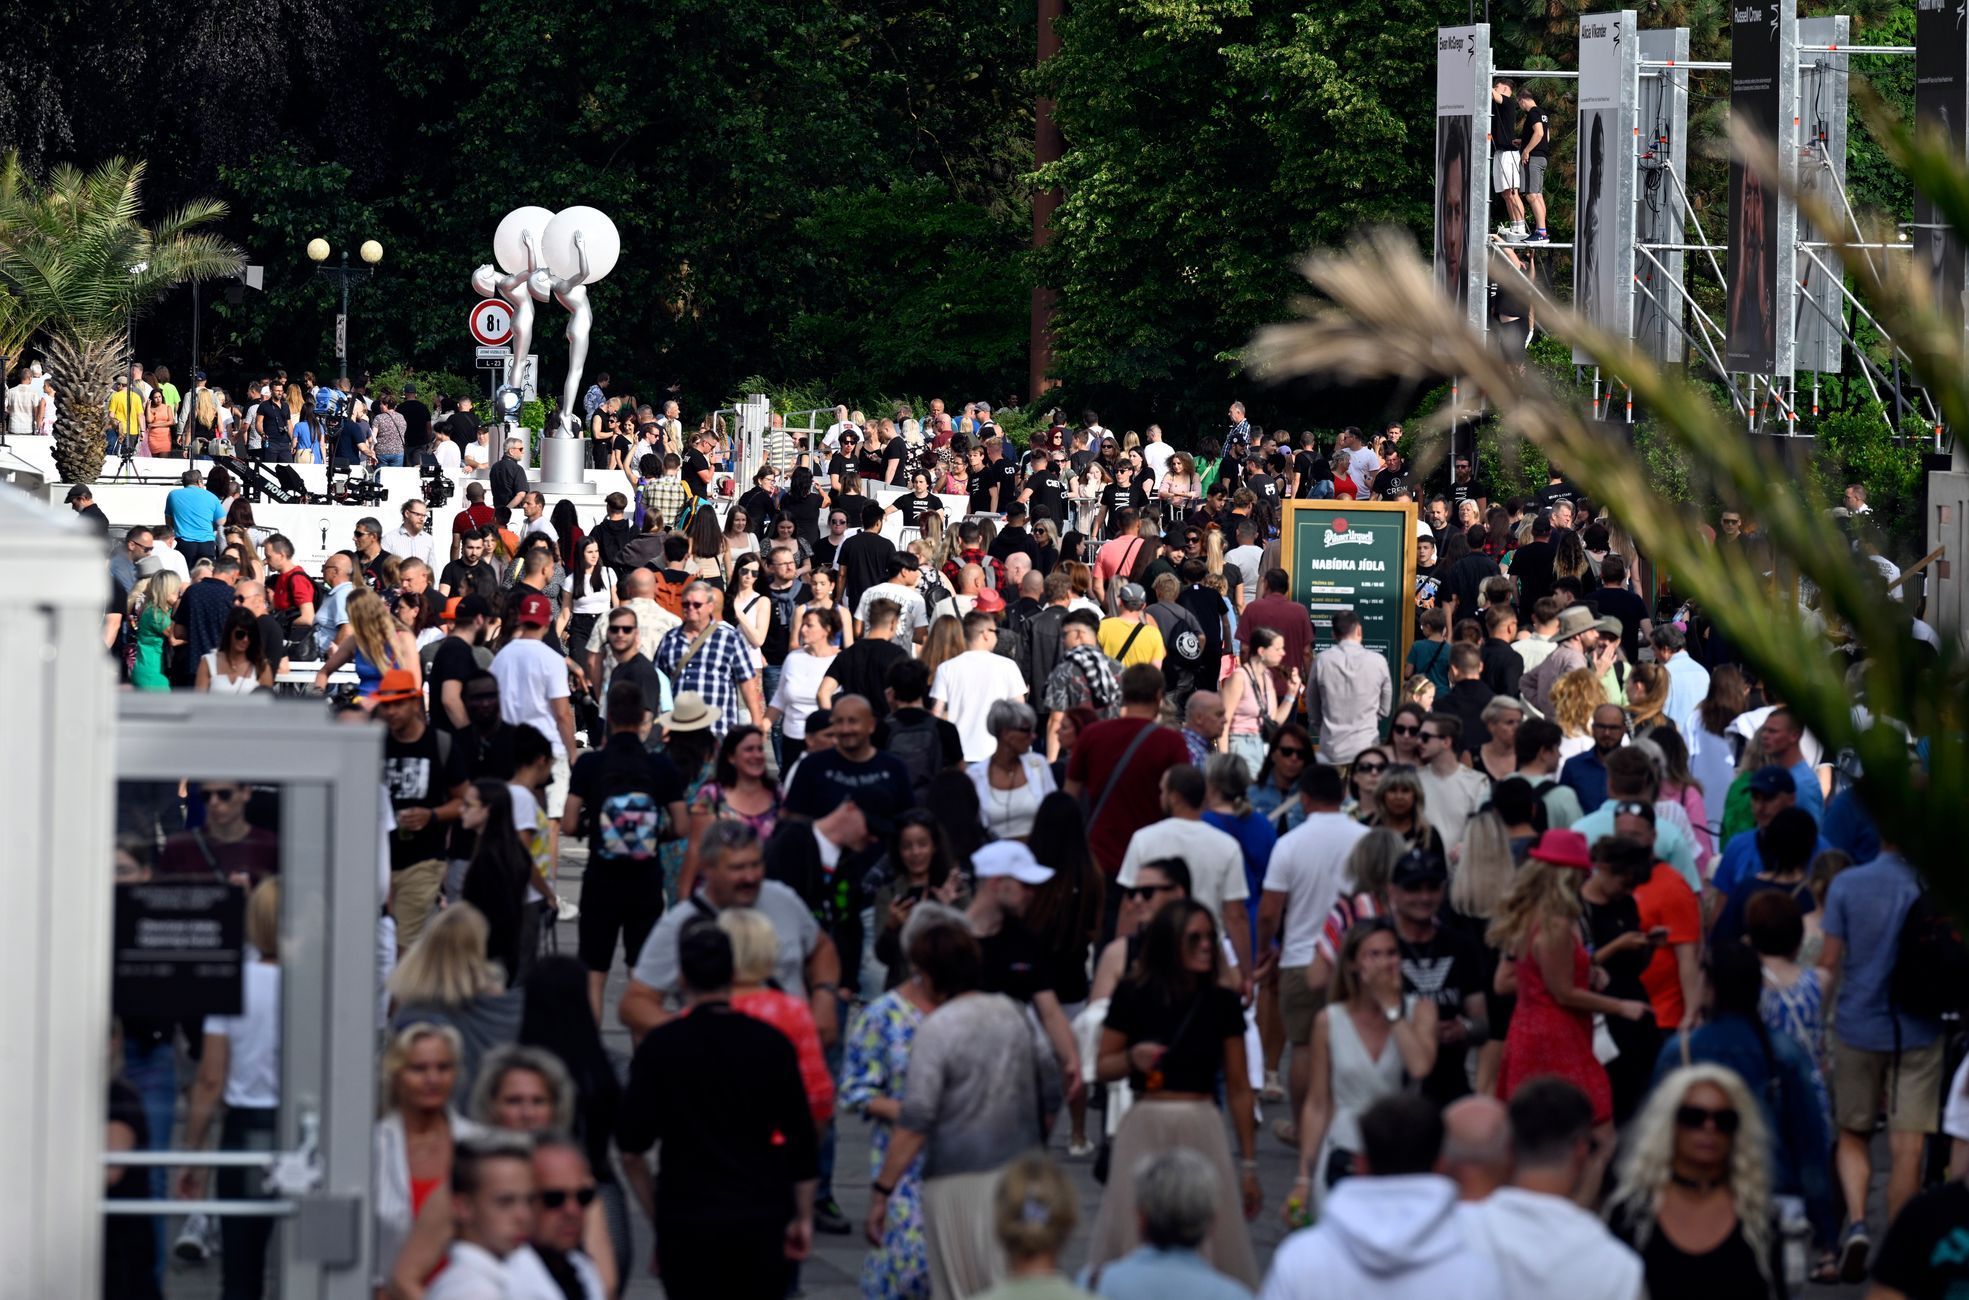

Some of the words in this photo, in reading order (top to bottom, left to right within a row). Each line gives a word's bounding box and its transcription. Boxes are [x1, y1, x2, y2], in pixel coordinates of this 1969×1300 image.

[264, 481, 291, 502] MOVIE
[1311, 557, 1356, 570] NABÍDKA
[1357, 558, 1385, 571] JÍDLA
